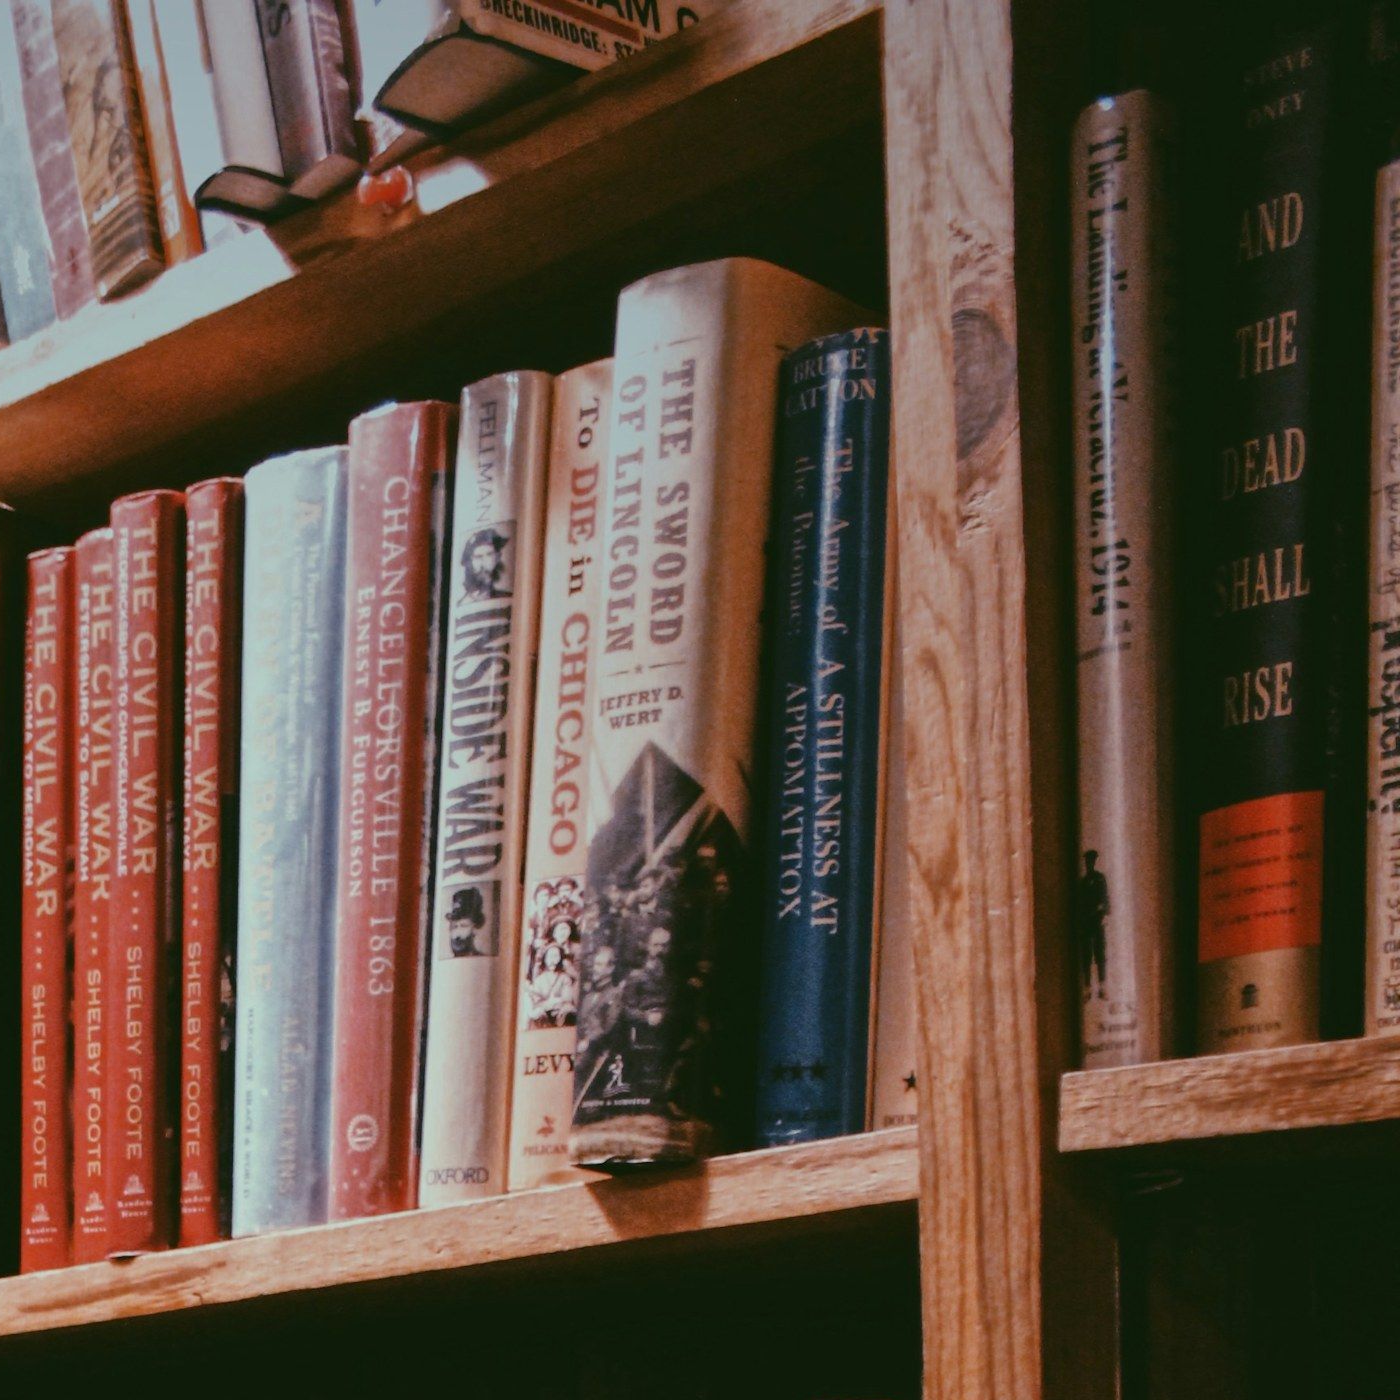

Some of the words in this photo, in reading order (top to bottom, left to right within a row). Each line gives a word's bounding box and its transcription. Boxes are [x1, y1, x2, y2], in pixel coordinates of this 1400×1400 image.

[1087, 127, 1129, 196] The
[1235, 191, 1305, 264] AND
[1233, 308, 1299, 381] THE
[620, 376, 648, 435] OF
[661, 358, 695, 458] THE
[569, 464, 597, 545] DIE
[1222, 426, 1306, 501] DEAD
[133, 519, 157, 613] THE
[194, 509, 219, 607] THE
[605, 451, 644, 653] LINCOLN
[647, 483, 690, 646] SWORD
[1087, 538, 1132, 618] 1914
[1216, 542, 1309, 618] SHALL
[34, 574, 57, 668] THE
[92, 559, 112, 647] THE
[118, 528, 129, 678] FREDERICKSBURG
[355, 587, 375, 687] ERNEST
[80, 584, 90, 726] PETERSBURG
[133, 632, 157, 756] CIVIL
[193, 624, 218, 750] CIVIL
[369, 476, 409, 896] CHANCELLORSVILLE
[446, 601, 513, 762] INSIDE
[1223, 660, 1293, 731] RISE
[34, 684, 56, 803] CIVIL
[549, 612, 591, 858] CHICAGO
[811, 694, 845, 876] STILLNESS
[80, 770, 90, 881] SAVANNAH
[133, 773, 157, 874] WAR
[193, 766, 217, 870] WAR
[444, 779, 503, 880] WAR
[777, 684, 808, 920] APPOMATTOX
[35, 818, 57, 915] WAR
[186, 943, 201, 1051] SHELBY
[369, 915, 396, 996] 1863
[31, 984, 46, 1088] SHELBY
[86, 969, 100, 1076] SHELBY
[87, 1088, 102, 1178] FOOTE
[126, 1066, 141, 1158] FOOTE
[425, 1166, 490, 1185] OXFORD
